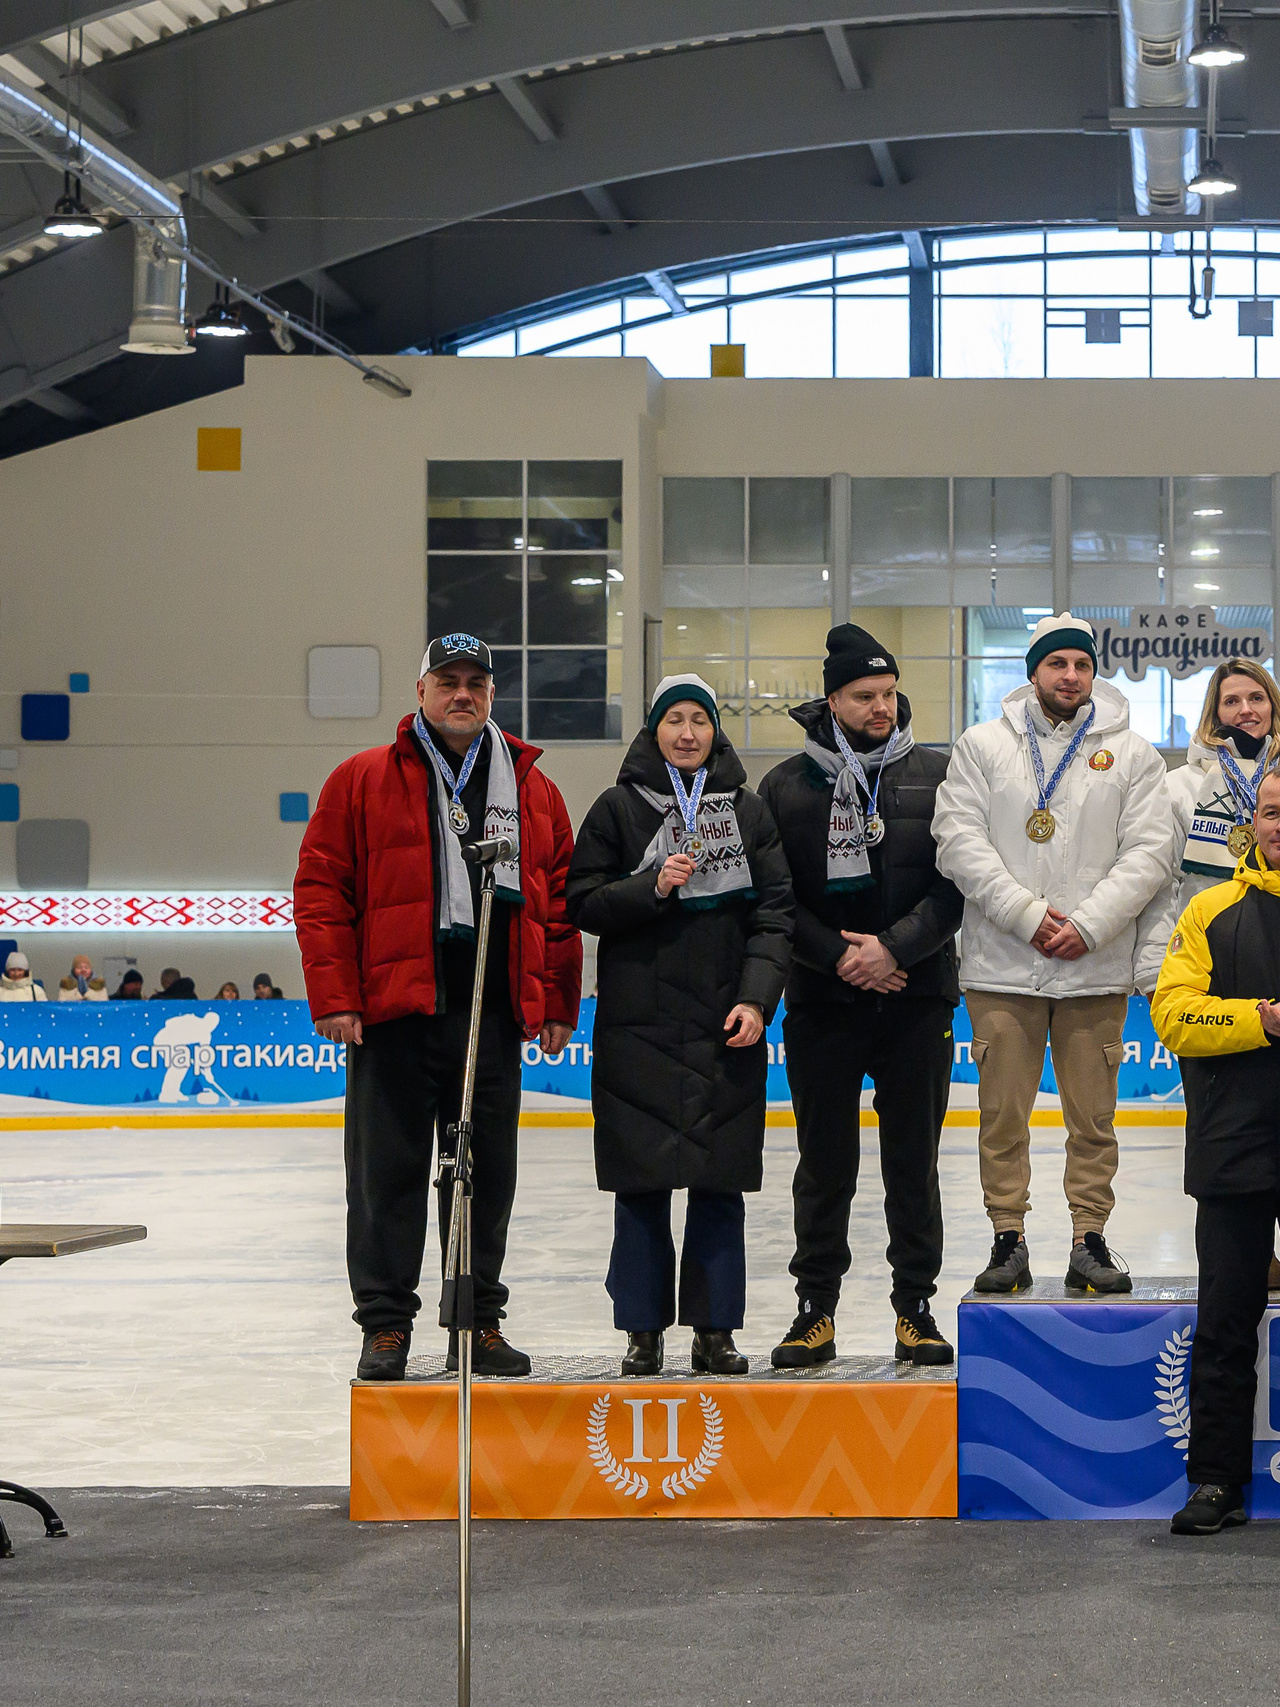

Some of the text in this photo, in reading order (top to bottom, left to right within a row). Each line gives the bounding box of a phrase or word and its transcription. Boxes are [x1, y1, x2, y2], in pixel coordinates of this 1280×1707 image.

[1139, 613, 1207, 628] КАФЕ
[672, 820, 734, 843] ЕИНЫЕ
[1191, 819, 1229, 836] БЕЛЫЕ
[1178, 1012, 1234, 1026] BEARUS
[623, 1398, 687, 1463] II
